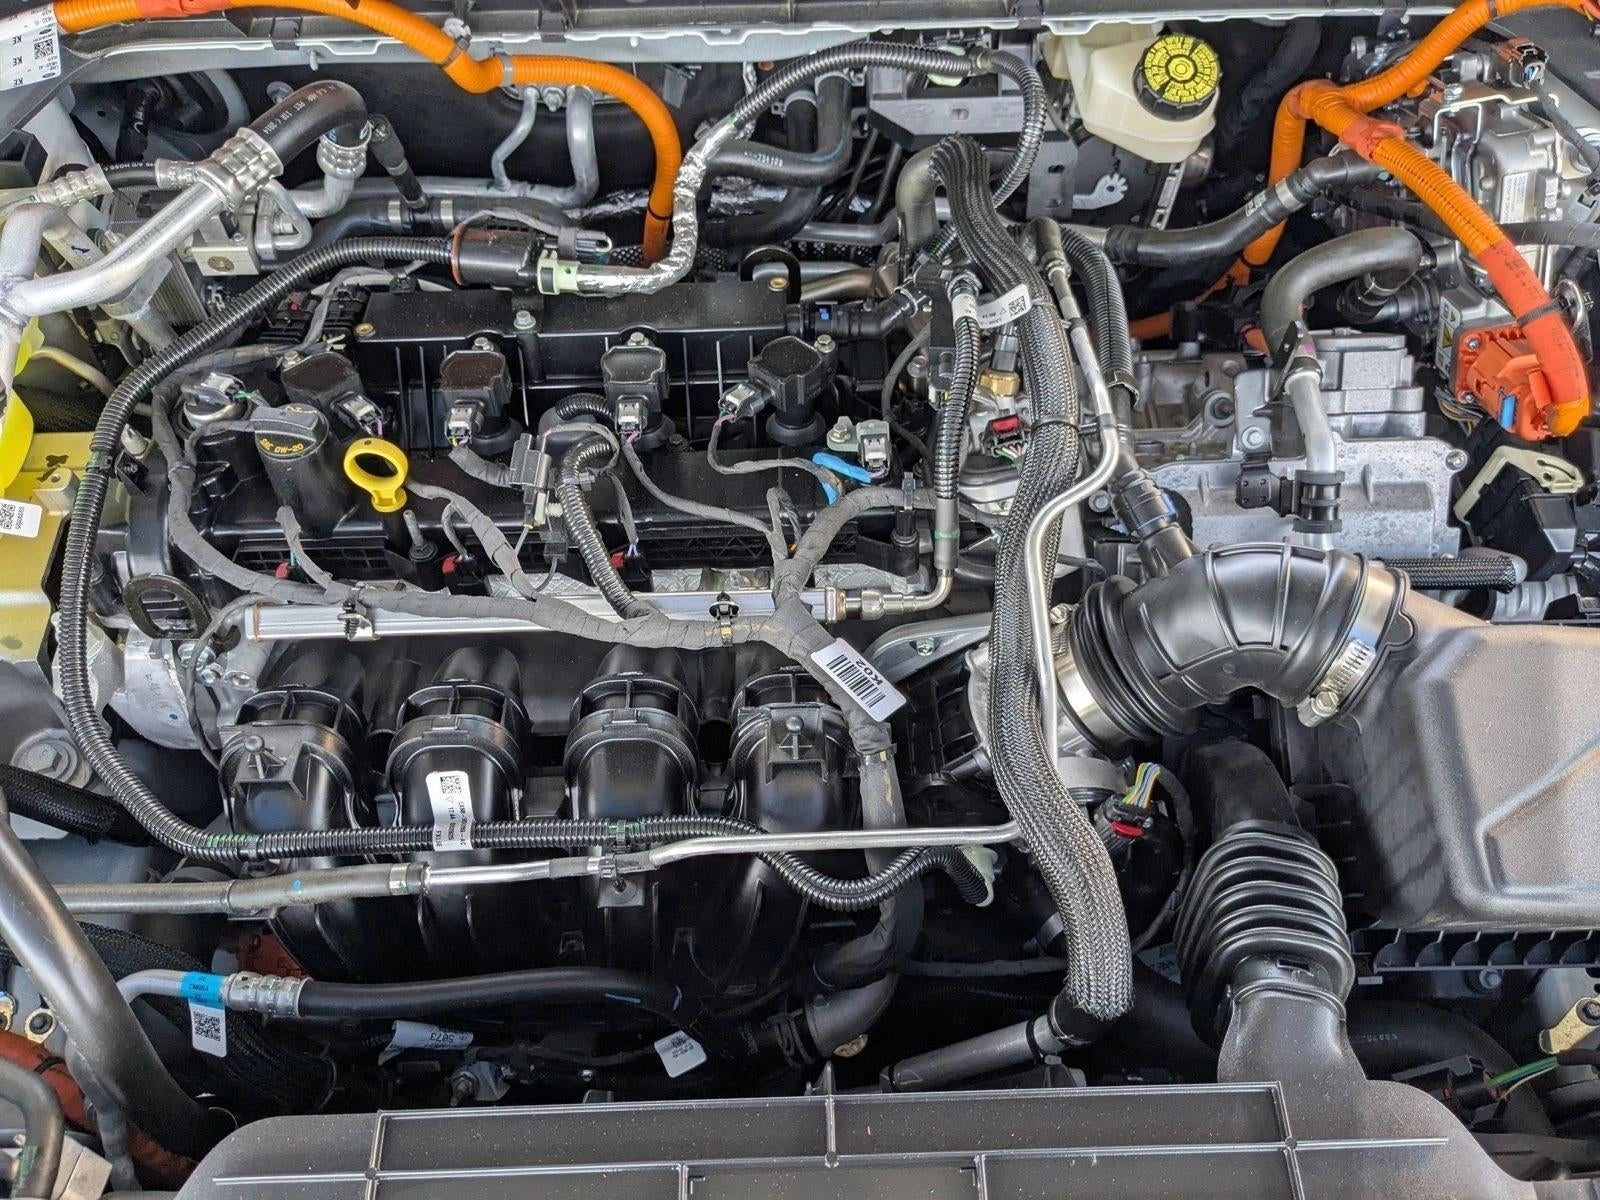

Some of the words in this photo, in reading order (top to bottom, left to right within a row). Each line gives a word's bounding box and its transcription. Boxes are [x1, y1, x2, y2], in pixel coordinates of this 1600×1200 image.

[12, 56, 23, 66] KE
[260, 438, 275, 451] SAE
[274, 443, 304, 454] 0W-20
